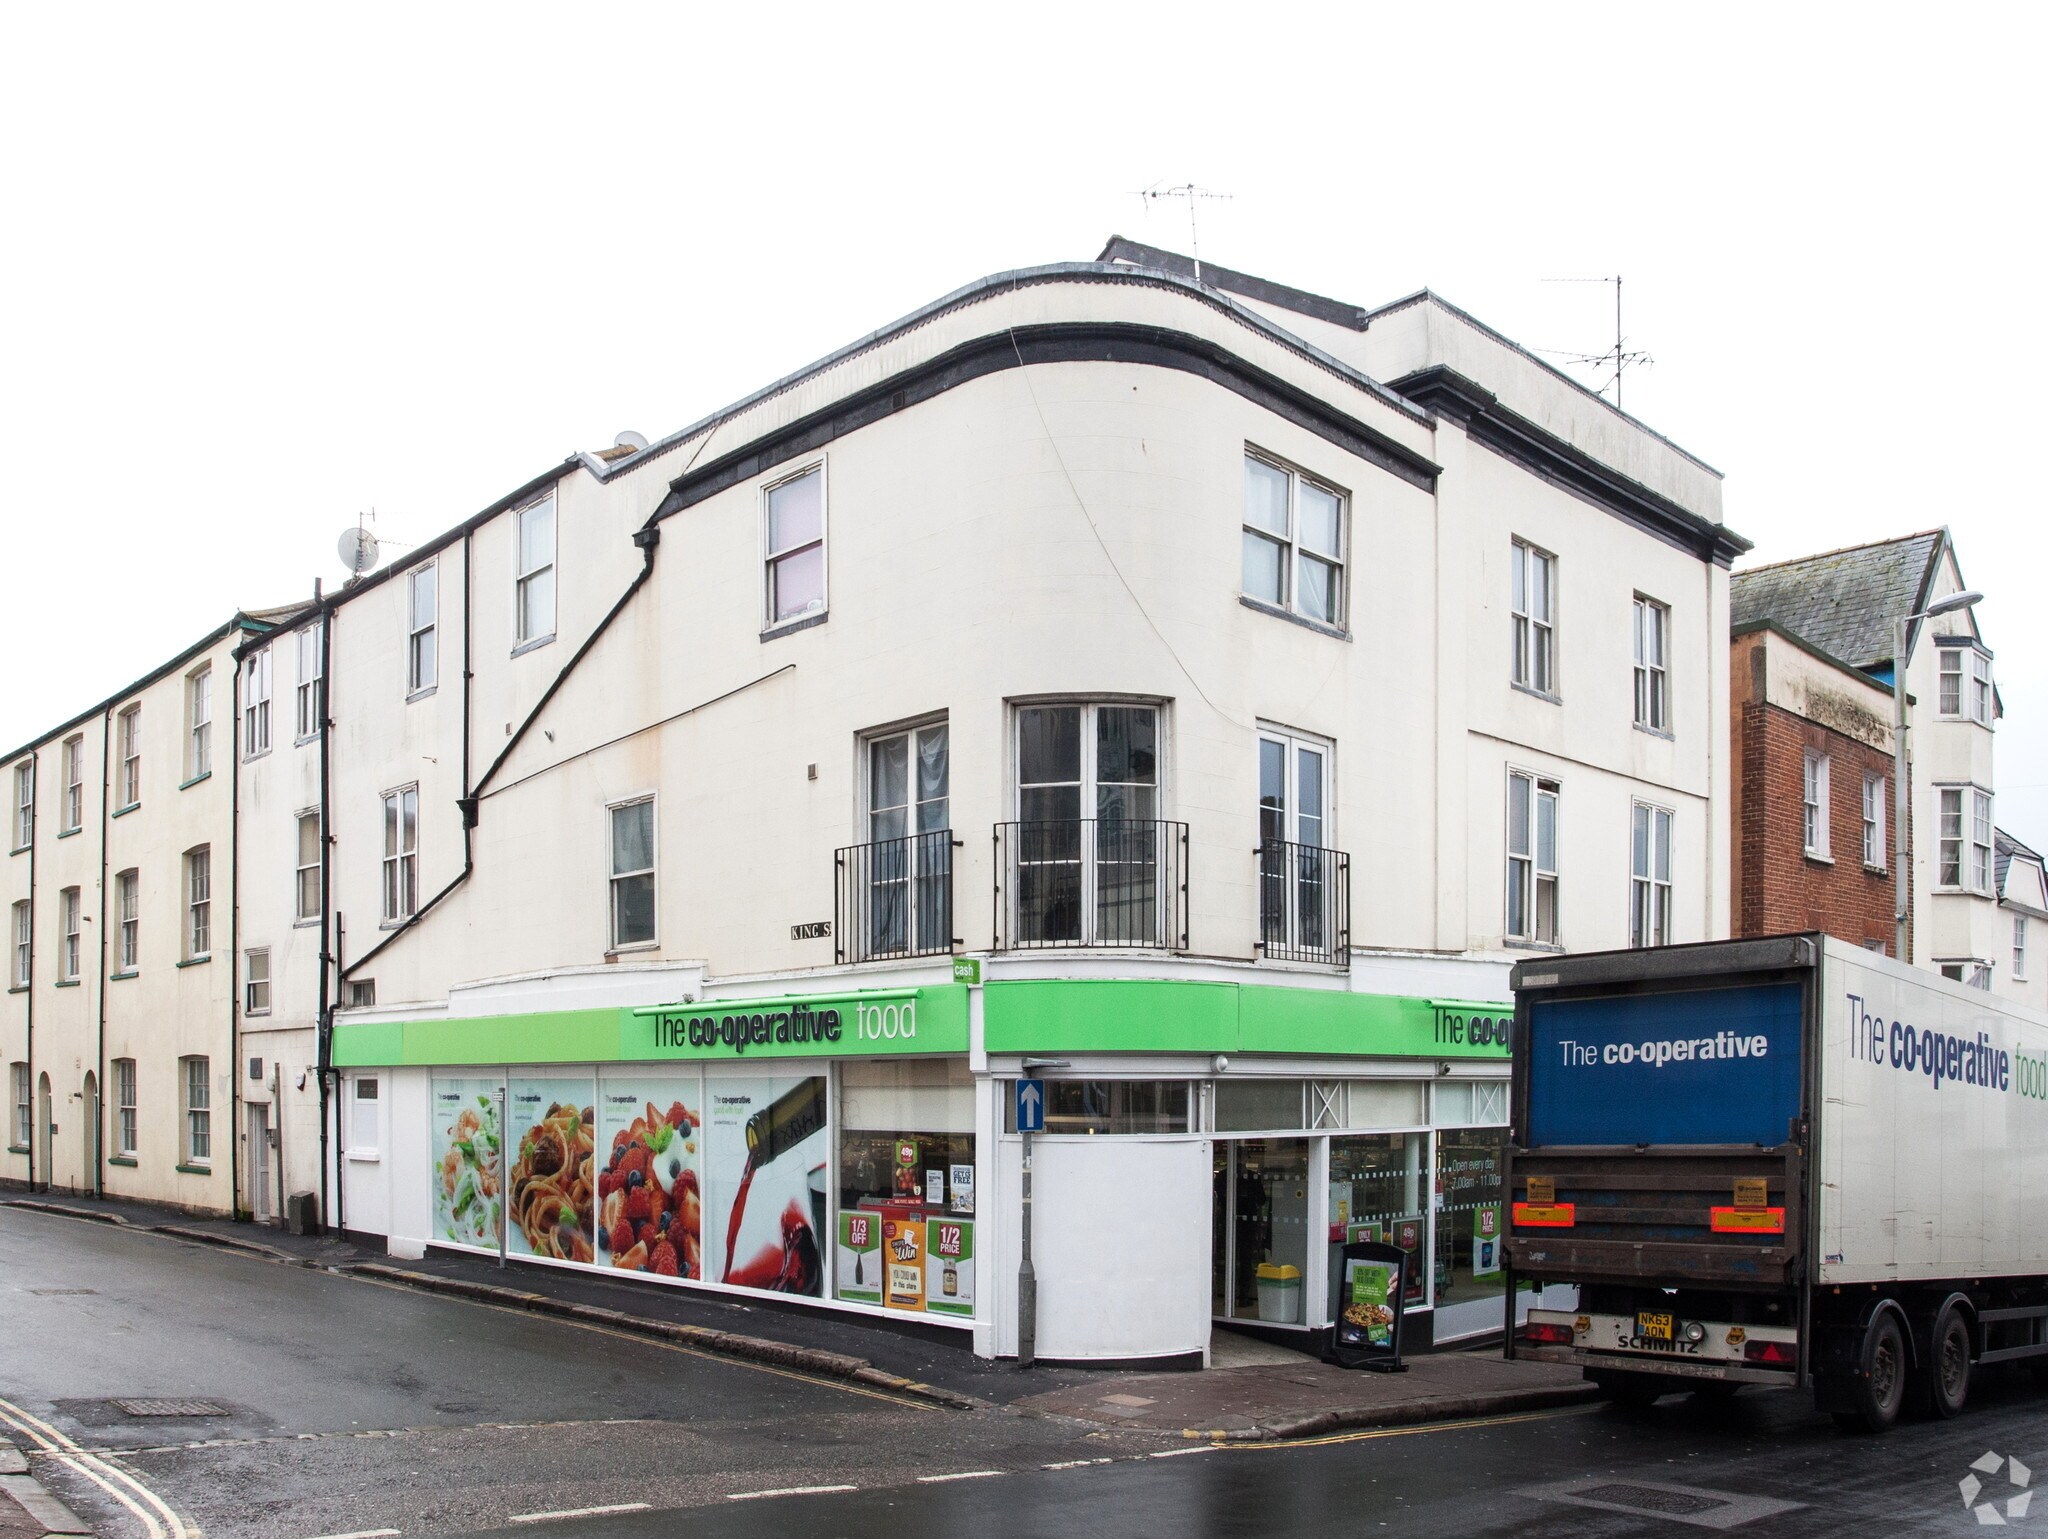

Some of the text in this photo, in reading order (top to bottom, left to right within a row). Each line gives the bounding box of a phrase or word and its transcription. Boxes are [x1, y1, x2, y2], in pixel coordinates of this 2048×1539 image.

[791, 924, 819, 939] KING
[954, 964, 973, 976] cash
[655, 998, 916, 1053] The co-operative food
[1434, 1008, 1463, 1044] The
[1558, 1030, 1768, 1068] The co-operative
[1846, 993, 2048, 1101] The co-operative food
[722, 1095, 751, 1106] co-operative
[901, 1147, 913, 1158] 49p
[1452, 1158, 1495, 1172] Open every day
[953, 1176, 971, 1184] FREE
[1452, 1177, 1475, 1189] 7.00am
[1482, 1211, 1494, 1226] 1/2
[851, 1219, 867, 1233] 1/3
[1403, 1226, 1415, 1239] 49p
[1482, 1225, 1494, 1233] PRICE
[851, 1233, 867, 1245] OFF
[940, 1226, 960, 1244] 1/2
[1358, 1228, 1371, 1239] ONLY
[897, 1244, 917, 1260] Win
[940, 1243, 960, 1254] PRICE
[906, 1281, 917, 1291] store
[1640, 1313, 1670, 1326] NK63
[1645, 1326, 1666, 1338] AON
[1617, 1335, 1699, 1354] SCHMITZ
